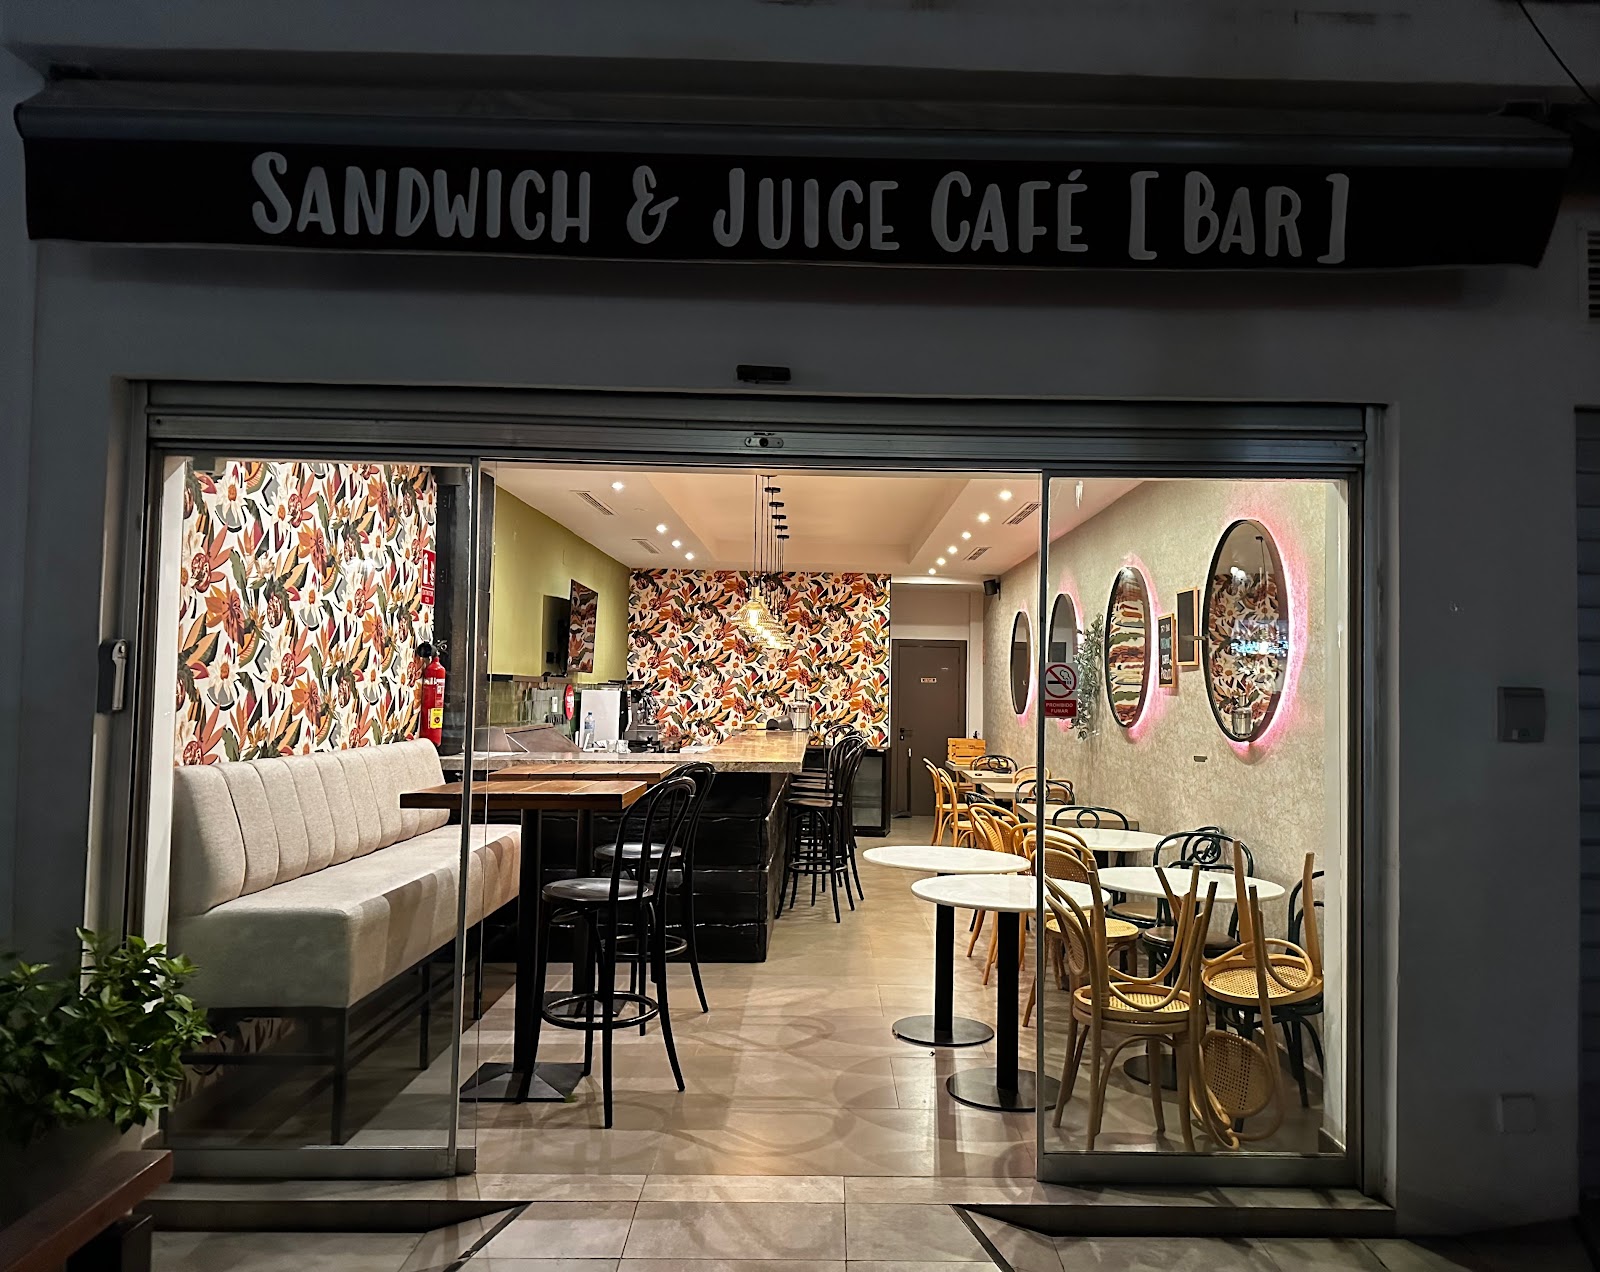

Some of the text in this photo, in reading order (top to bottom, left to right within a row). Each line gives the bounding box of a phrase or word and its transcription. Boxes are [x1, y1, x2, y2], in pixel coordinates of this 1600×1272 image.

[251, 151, 592, 243] SANDWICH
[627, 165, 679, 245] &
[713, 167, 900, 250] JUICE
[931, 168, 1089, 253] CAFÉ
[1184, 170, 1303, 258] BAR
